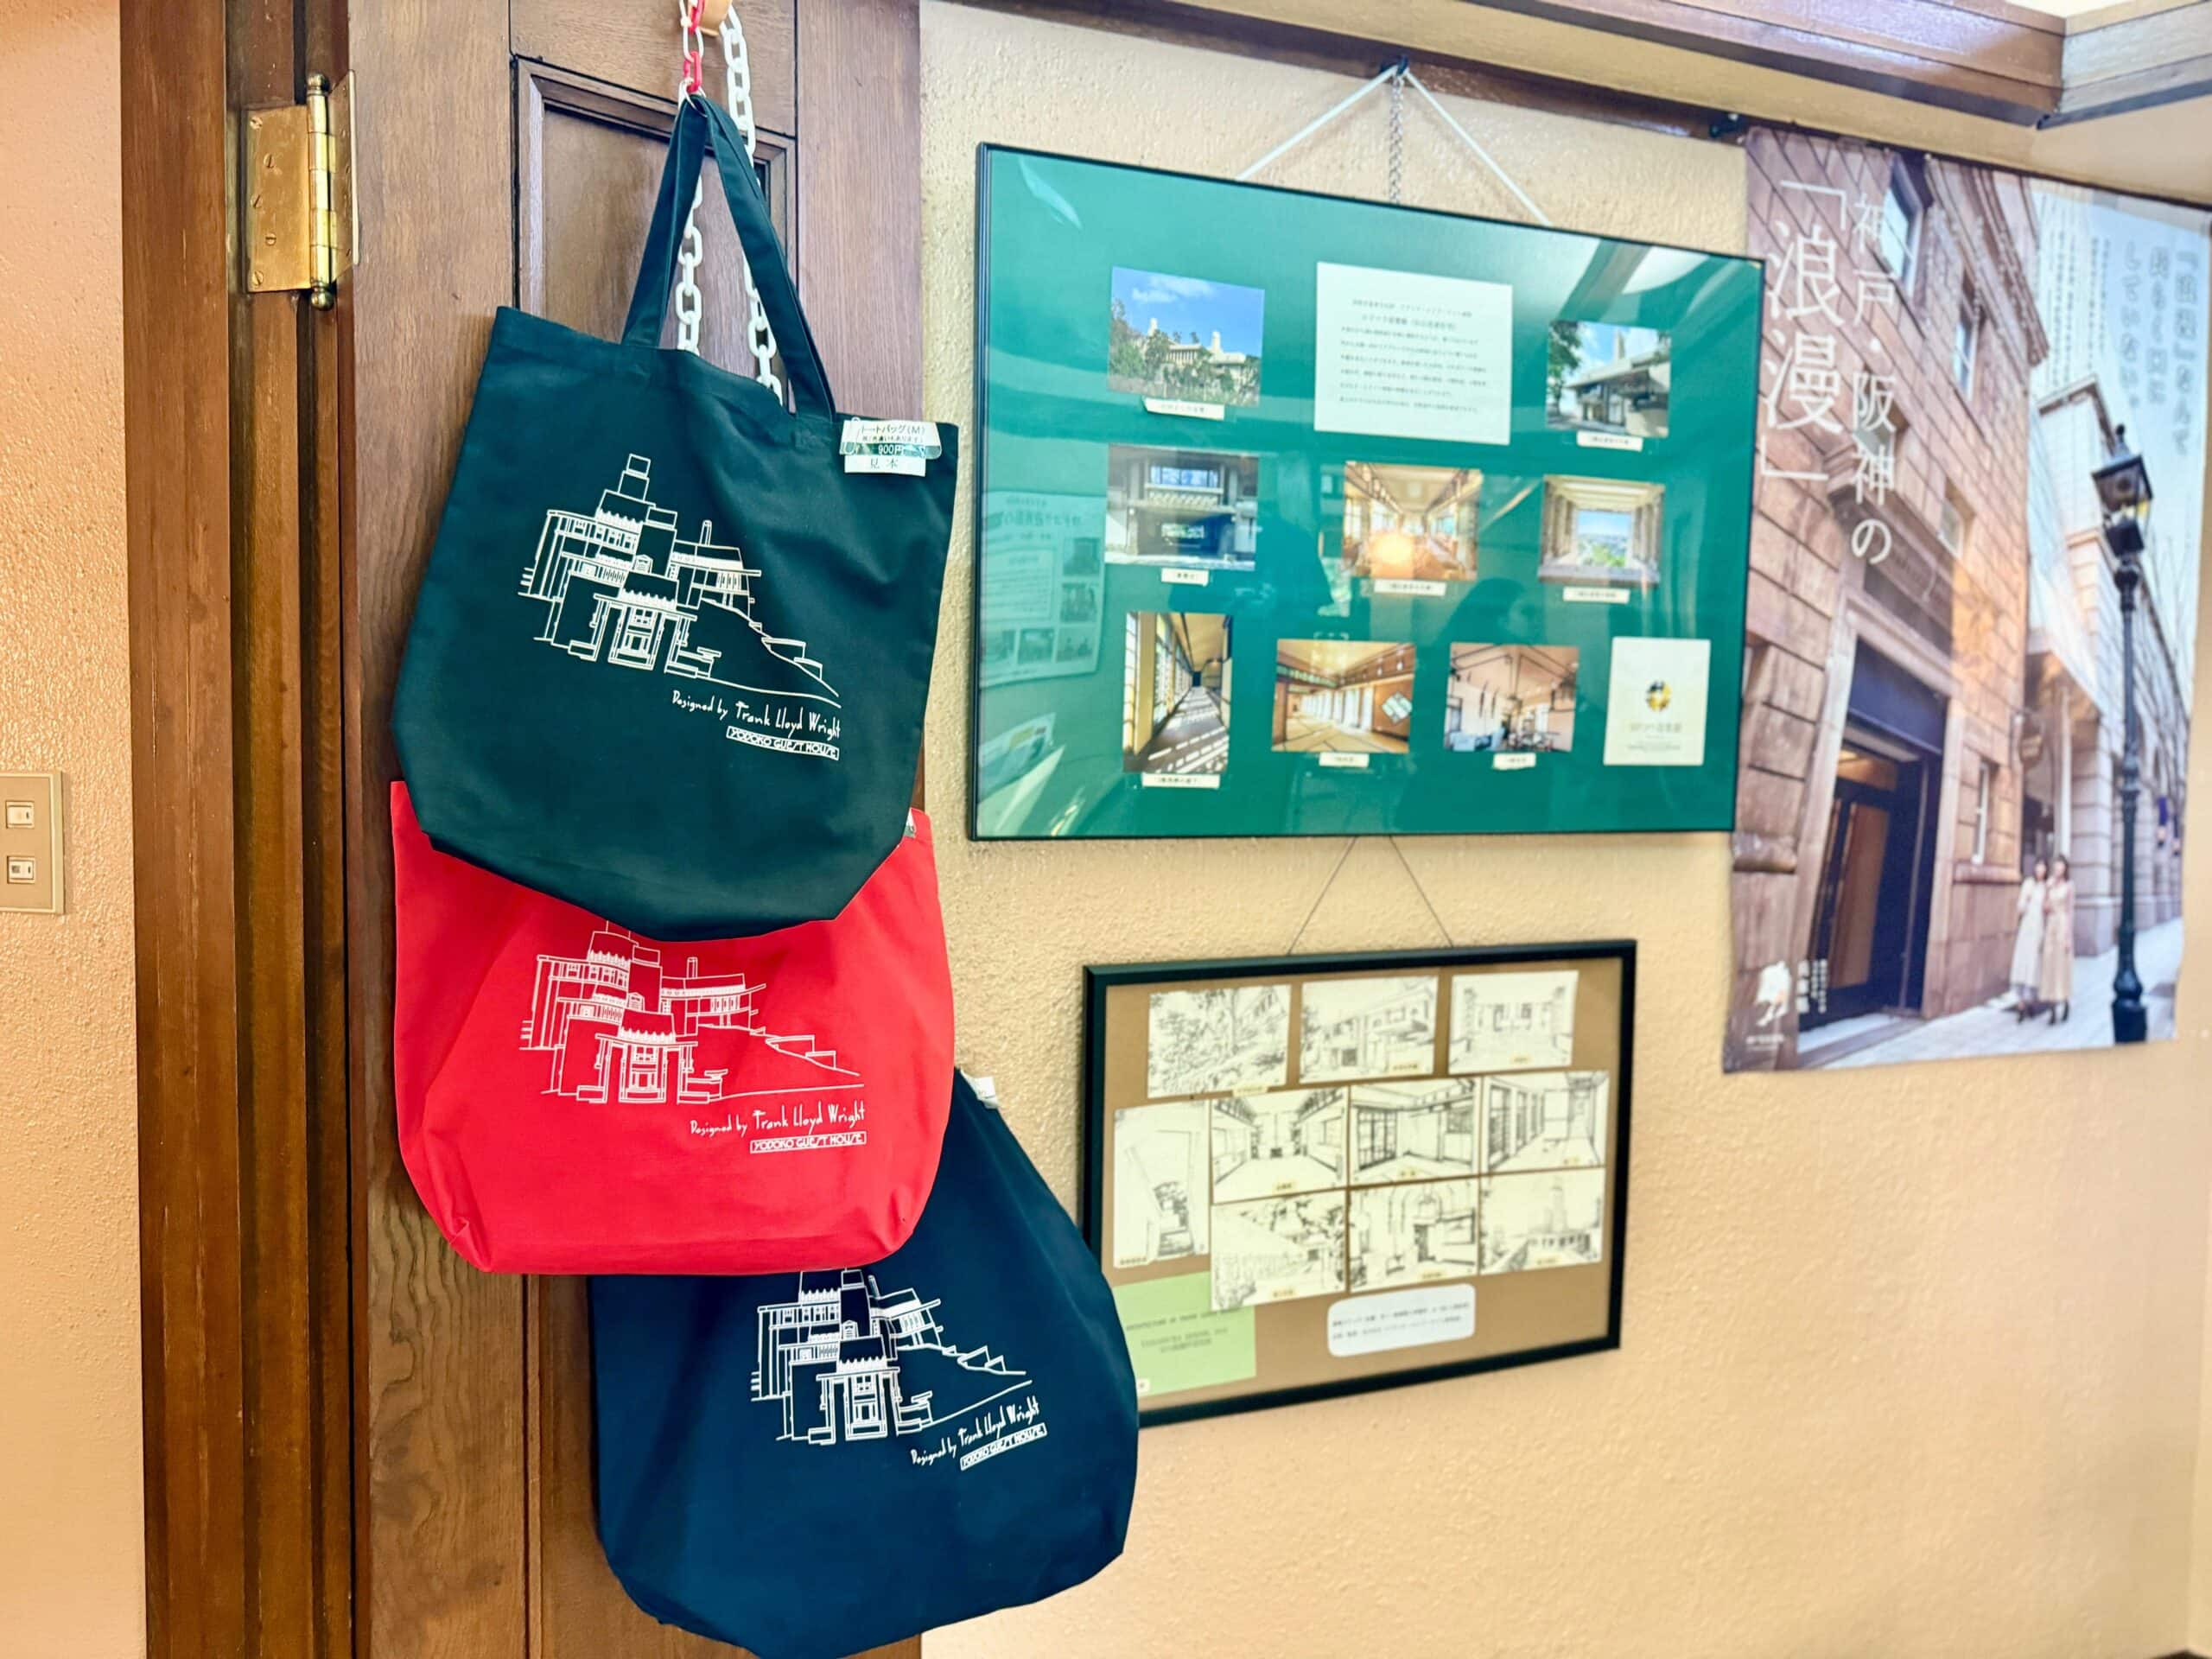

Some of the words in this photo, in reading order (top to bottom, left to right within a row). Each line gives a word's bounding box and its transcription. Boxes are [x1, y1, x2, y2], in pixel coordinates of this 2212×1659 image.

[1851, 192, 1898, 565] 神戸・阪神の
[671, 690, 715, 712] Designed
[717, 698, 728, 721] by
[735, 701, 771, 727] Frank
[775, 707, 804, 739] Lloyd
[809, 711, 842, 741] Wright
[690, 1114, 733, 1137] Designed
[735, 1115, 748, 1138] by
[752, 1105, 789, 1130] Frank
[792, 1101, 823, 1135] Lloyd
[828, 1099, 865, 1128] Wright
[910, 1437, 947, 1466] Designed
[947, 1437, 957, 1459] by
[983, 1405, 1007, 1440] Lloyd
[1006, 1395, 1039, 1426] Wright
